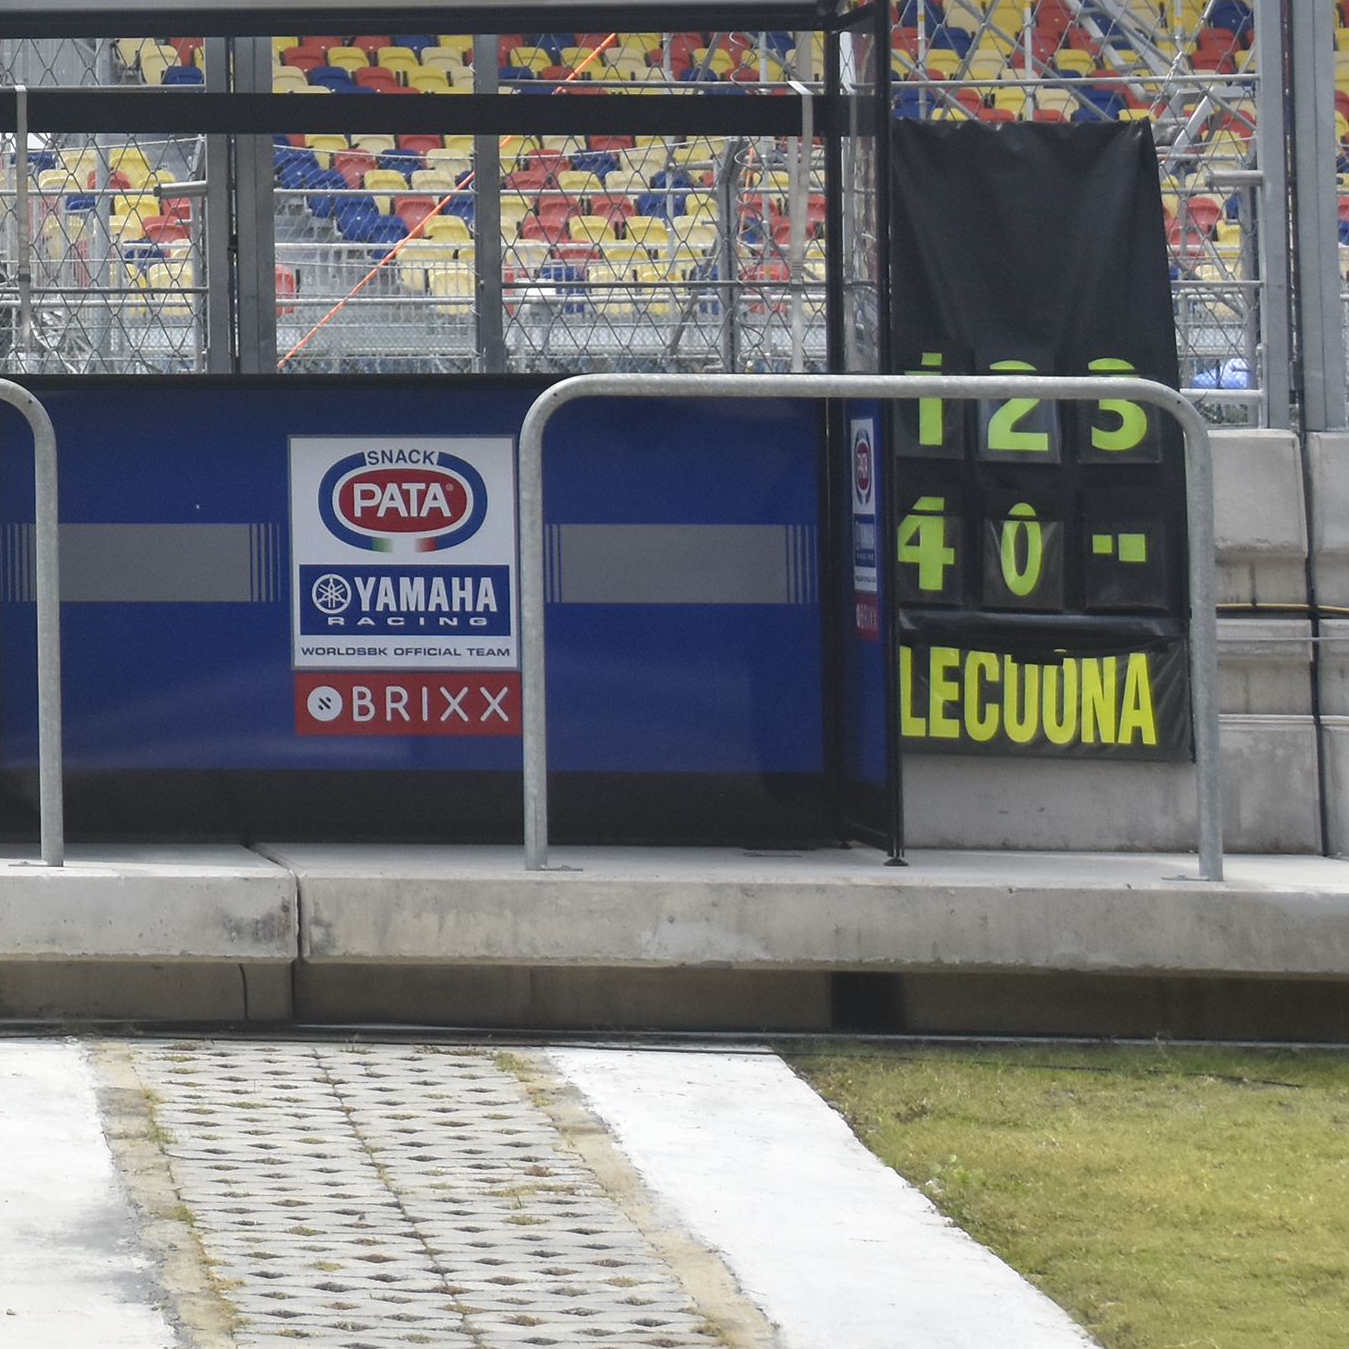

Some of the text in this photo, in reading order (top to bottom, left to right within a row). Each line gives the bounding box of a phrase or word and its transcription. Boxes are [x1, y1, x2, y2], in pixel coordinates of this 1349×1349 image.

[366, 449, 436, 466] SNACK
[353, 482, 453, 518] PATA
[354, 576, 498, 612] YAMAHA
[327, 616, 488, 626] RACING
[301, 646, 511, 657] WORLDSBK OFFICIAL TEAM
[351, 685, 510, 722] BRIXX
[898, 645, 1157, 746] LECUONA
